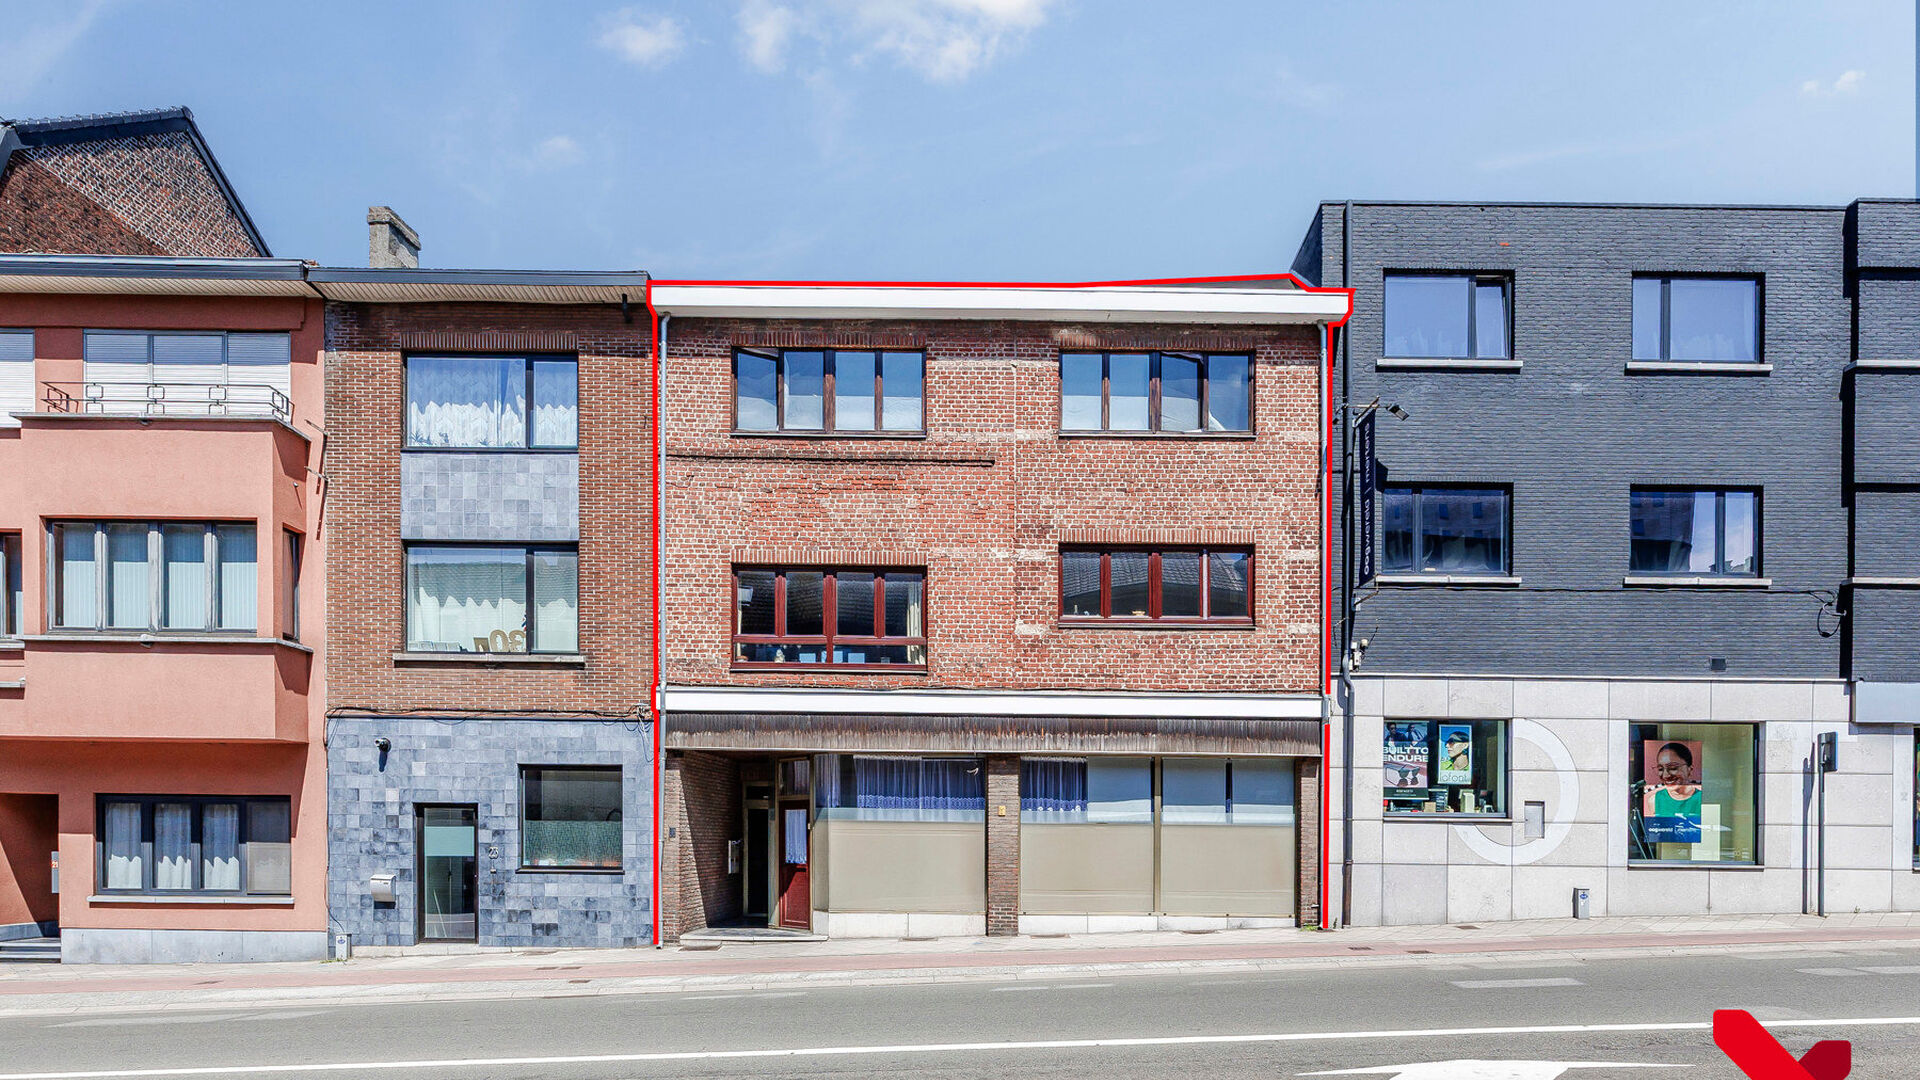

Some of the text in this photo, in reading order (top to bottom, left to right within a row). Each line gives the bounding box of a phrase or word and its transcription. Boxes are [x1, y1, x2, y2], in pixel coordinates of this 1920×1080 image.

[1363, 499, 1371, 575] oogwereld
[1383, 746, 1429, 755] BUILT TO
[1383, 754, 1429, 763] ENDURE
